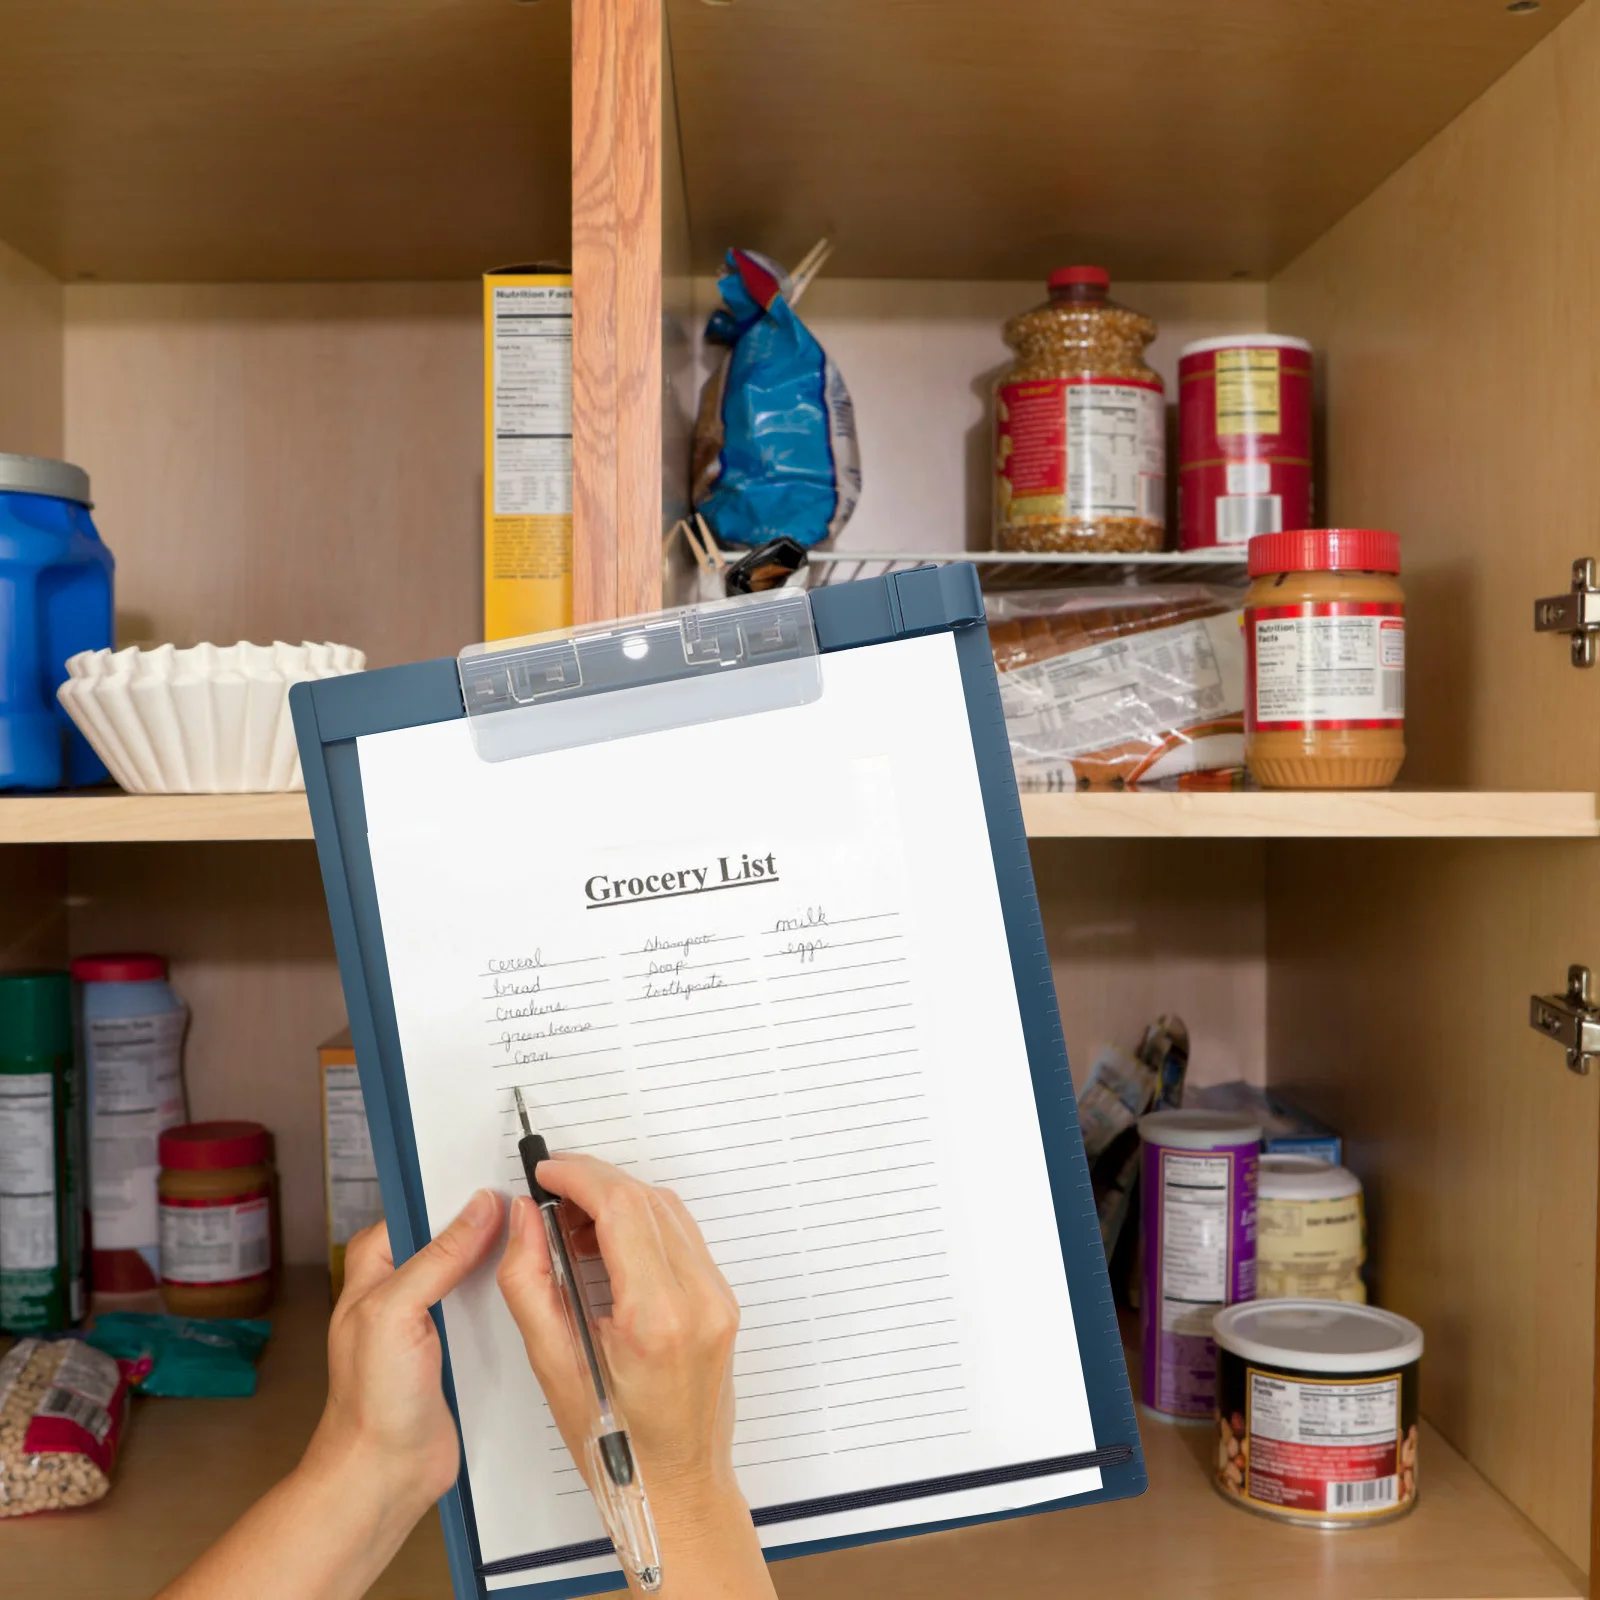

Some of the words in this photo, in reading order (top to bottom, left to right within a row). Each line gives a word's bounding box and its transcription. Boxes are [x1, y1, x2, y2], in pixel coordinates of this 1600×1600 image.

[496, 289, 545, 299] Nutrition
[548, 289, 573, 299] Fact
[1258, 623, 1296, 633] Nutrition
[1258, 634, 1279, 643] Facts
[585, 867, 708, 901] Grocery
[717, 852, 778, 882] List
[775, 906, 828, 933] milk
[644, 934, 718, 957] shampoo
[778, 939, 829, 964] eggs
[488, 948, 547, 973] cereal
[648, 960, 688, 976] soap
[494, 976, 541, 997] bread
[643, 973, 725, 1001] toothpaste
[496, 999, 570, 1021] crackers
[1254, 1377, 1286, 1391] Nutrition
